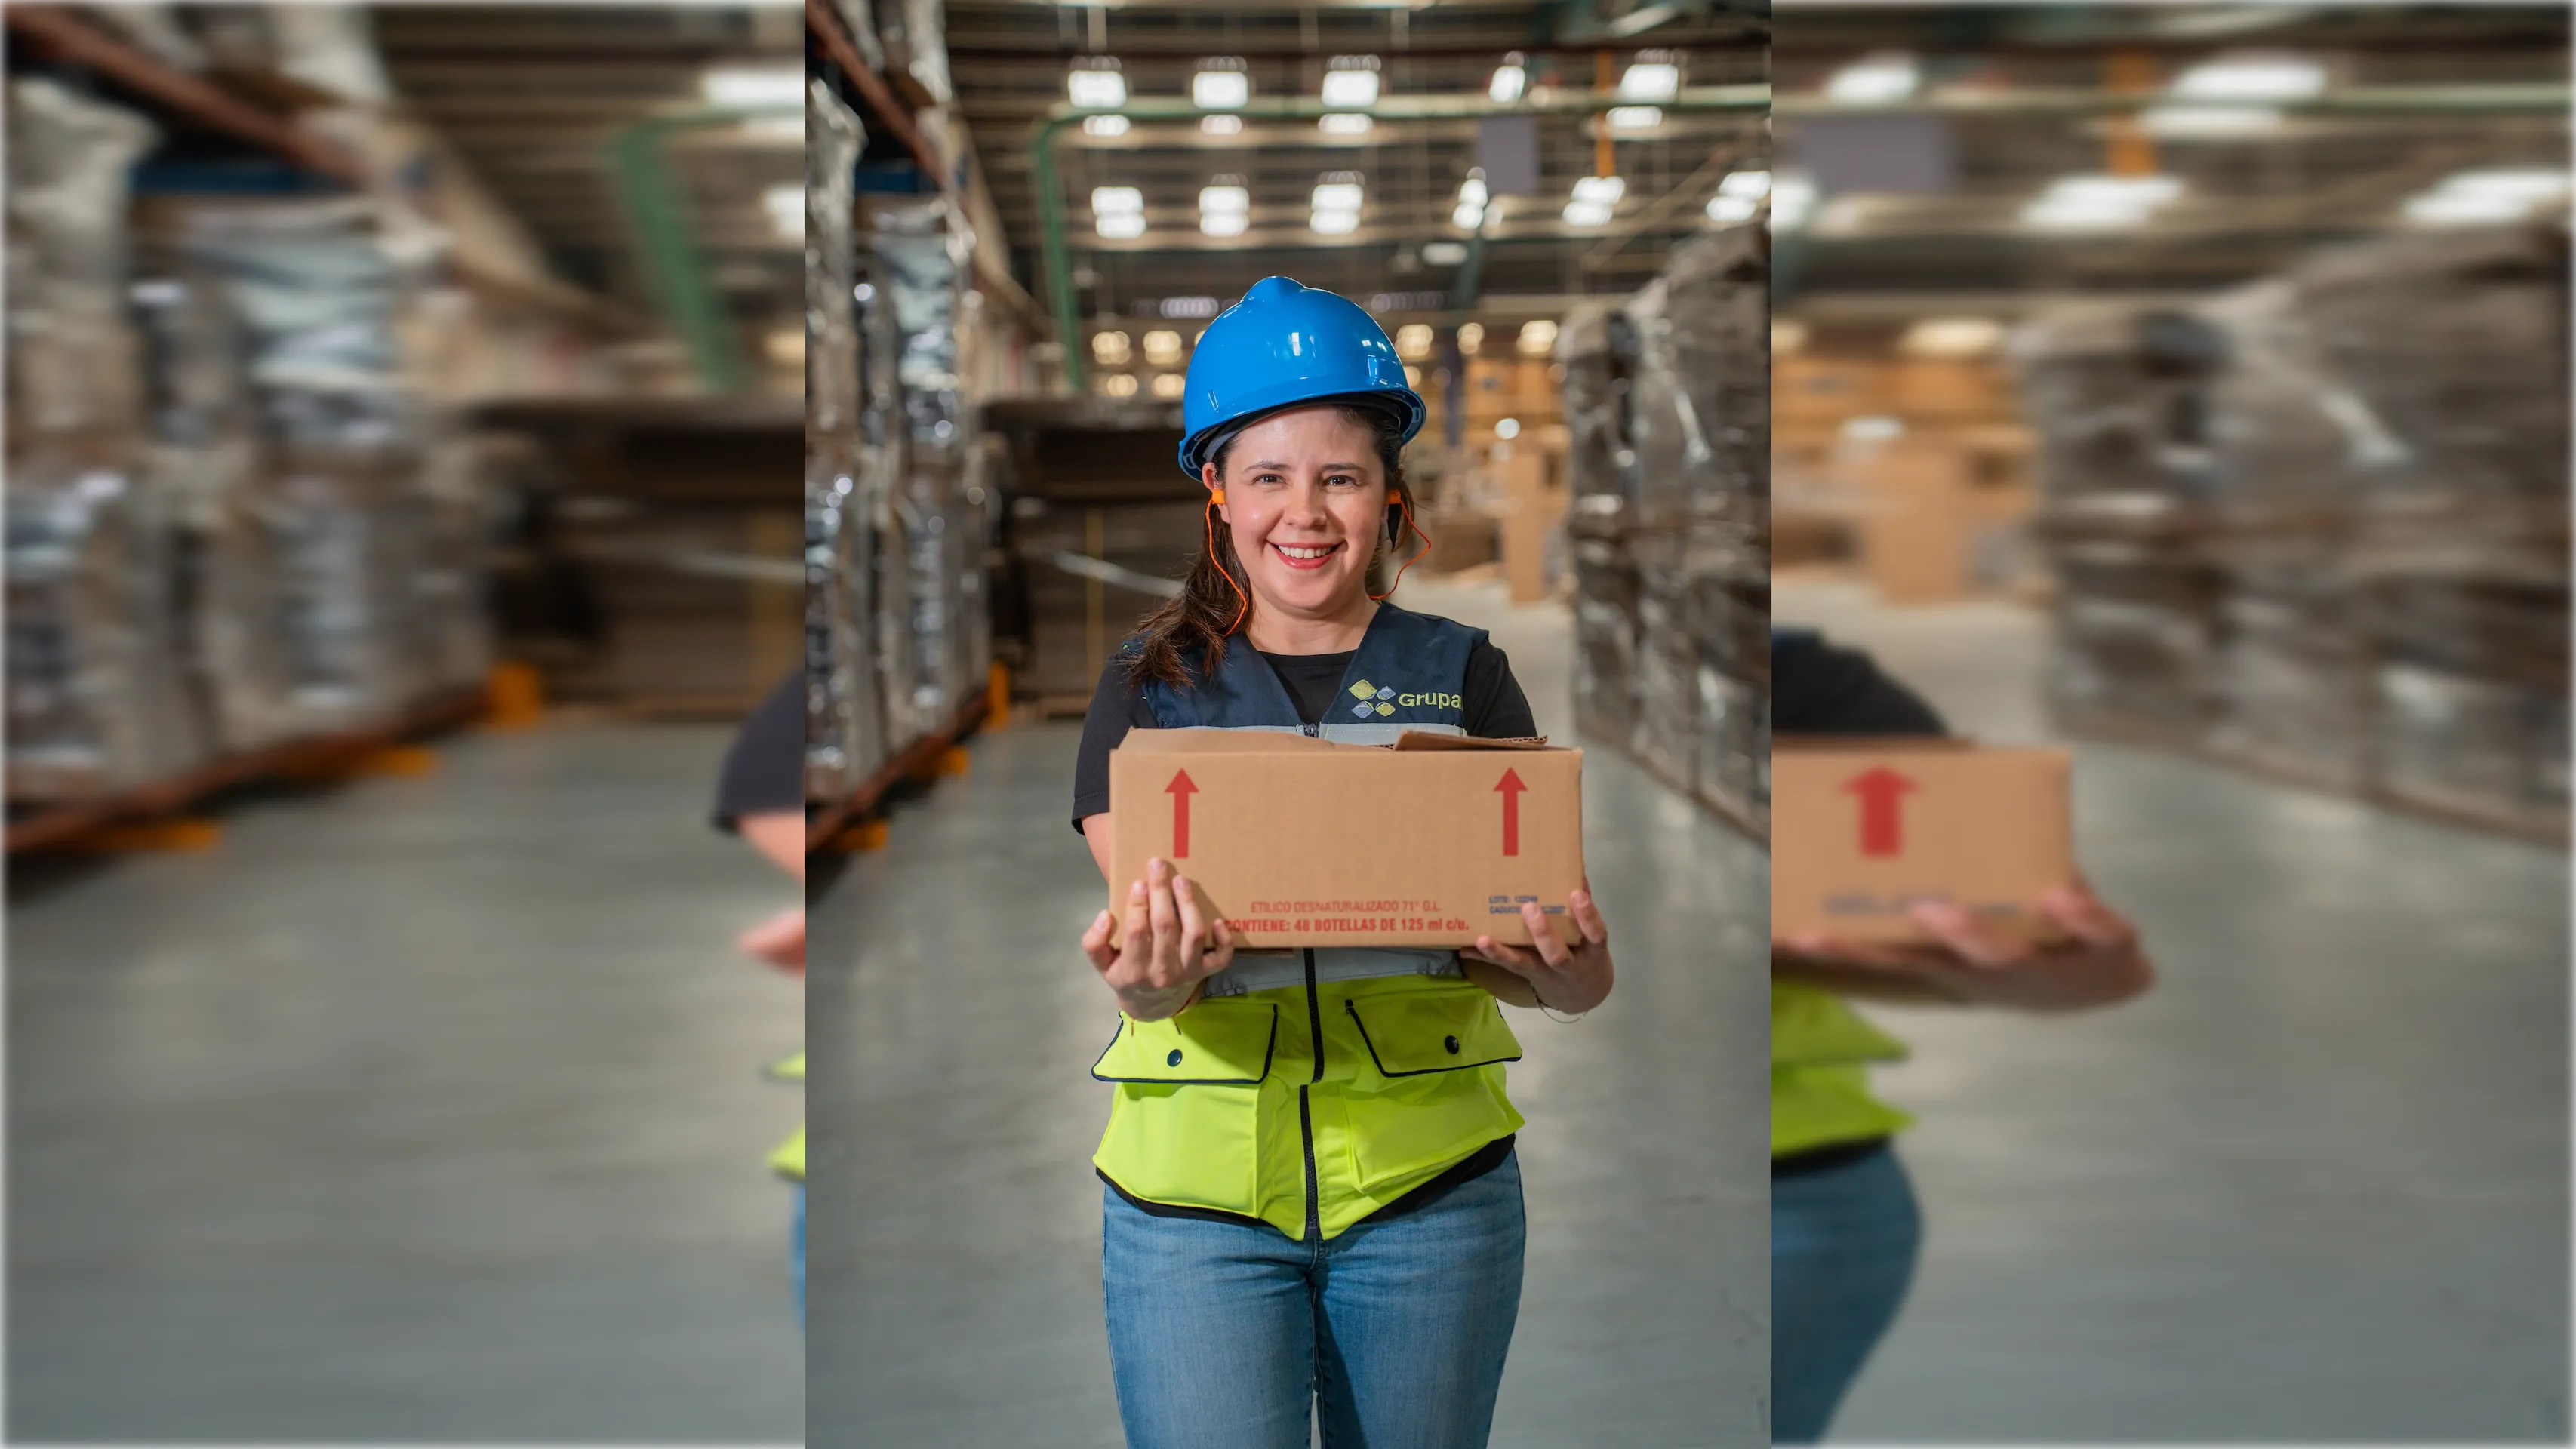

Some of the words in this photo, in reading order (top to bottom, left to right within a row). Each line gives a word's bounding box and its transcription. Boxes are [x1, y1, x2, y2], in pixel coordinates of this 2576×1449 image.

[1398, 692, 1463, 711] Grupa
[1294, 900, 1399, 912] DESNATURALIZADO
[1224, 918, 1290, 932] CONTIENE:
[1294, 918, 1310, 932] 48
[1314, 918, 1377, 931] BOTELLAS
[1380, 918, 1396, 931] DE
[1401, 918, 1424, 931] 125
[1428, 918, 1443, 931] ml
[1446, 917, 1470, 931] c/u.
